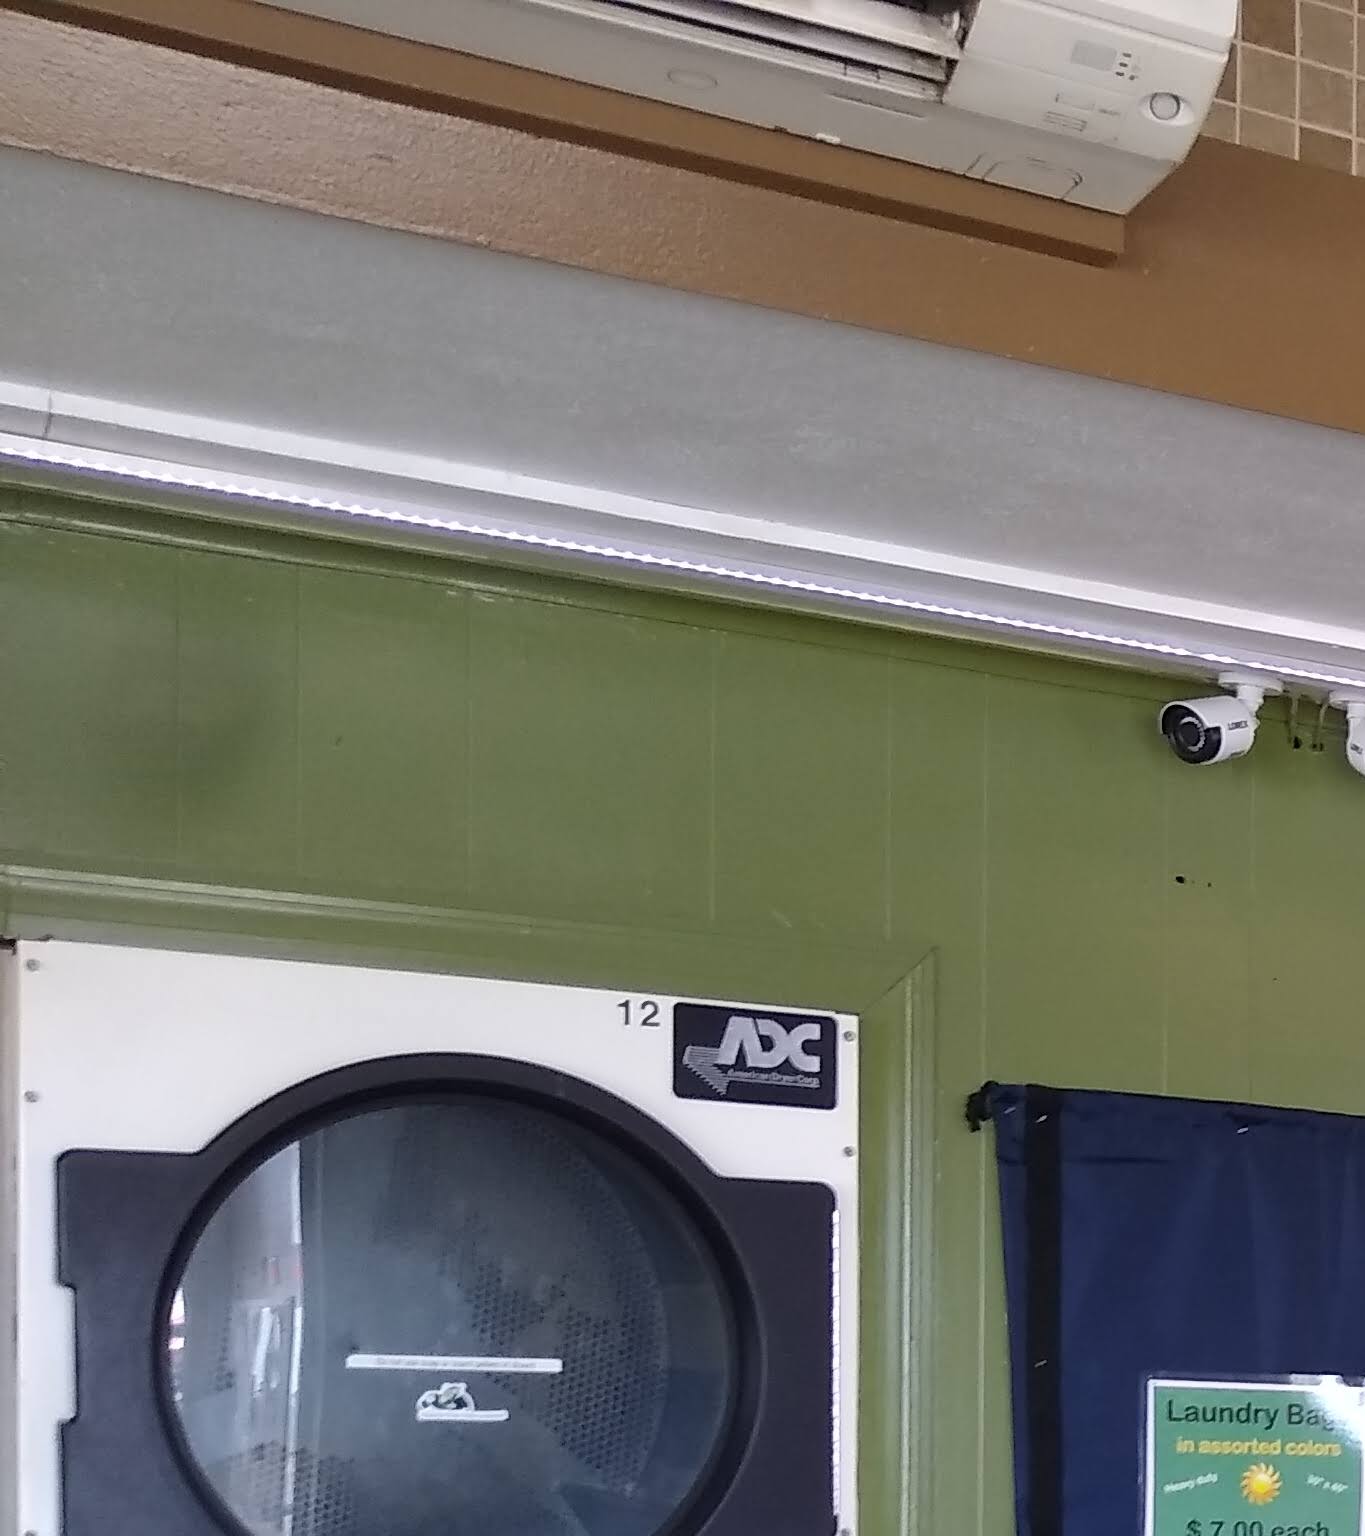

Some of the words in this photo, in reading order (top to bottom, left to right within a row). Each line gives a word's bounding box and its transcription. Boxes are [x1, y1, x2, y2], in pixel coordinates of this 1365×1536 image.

[617, 999, 661, 1028] 12
[714, 1015, 822, 1074] ADC
[1167, 1398, 1279, 1431] Laundry
[1287, 1402, 1336, 1432] Bag
[1176, 1436, 1196, 1455] in
[1198, 1437, 1281, 1456] assorted
[1284, 1438, 1342, 1457] colors
